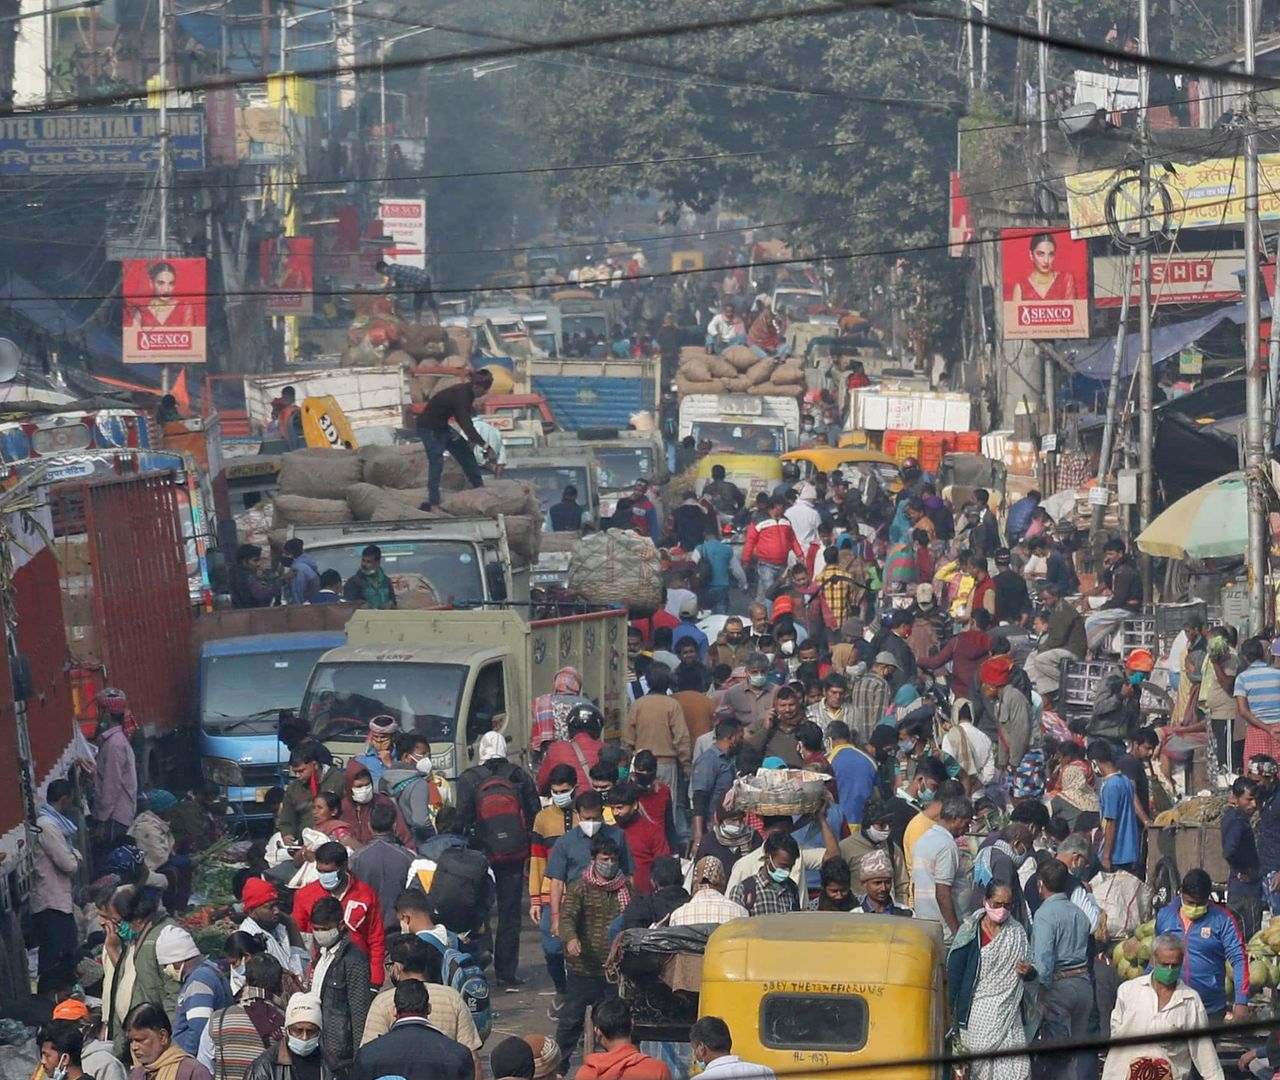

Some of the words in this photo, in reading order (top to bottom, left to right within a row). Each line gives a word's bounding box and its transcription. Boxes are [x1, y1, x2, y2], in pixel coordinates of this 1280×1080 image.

[42, 116, 137, 139] ORIENTAL
[142, 114, 200, 137] HME
[1031, 307, 1072, 320] SENCO
[149, 333, 189, 345] SENCO
[763, 979, 788, 992] OBEY
